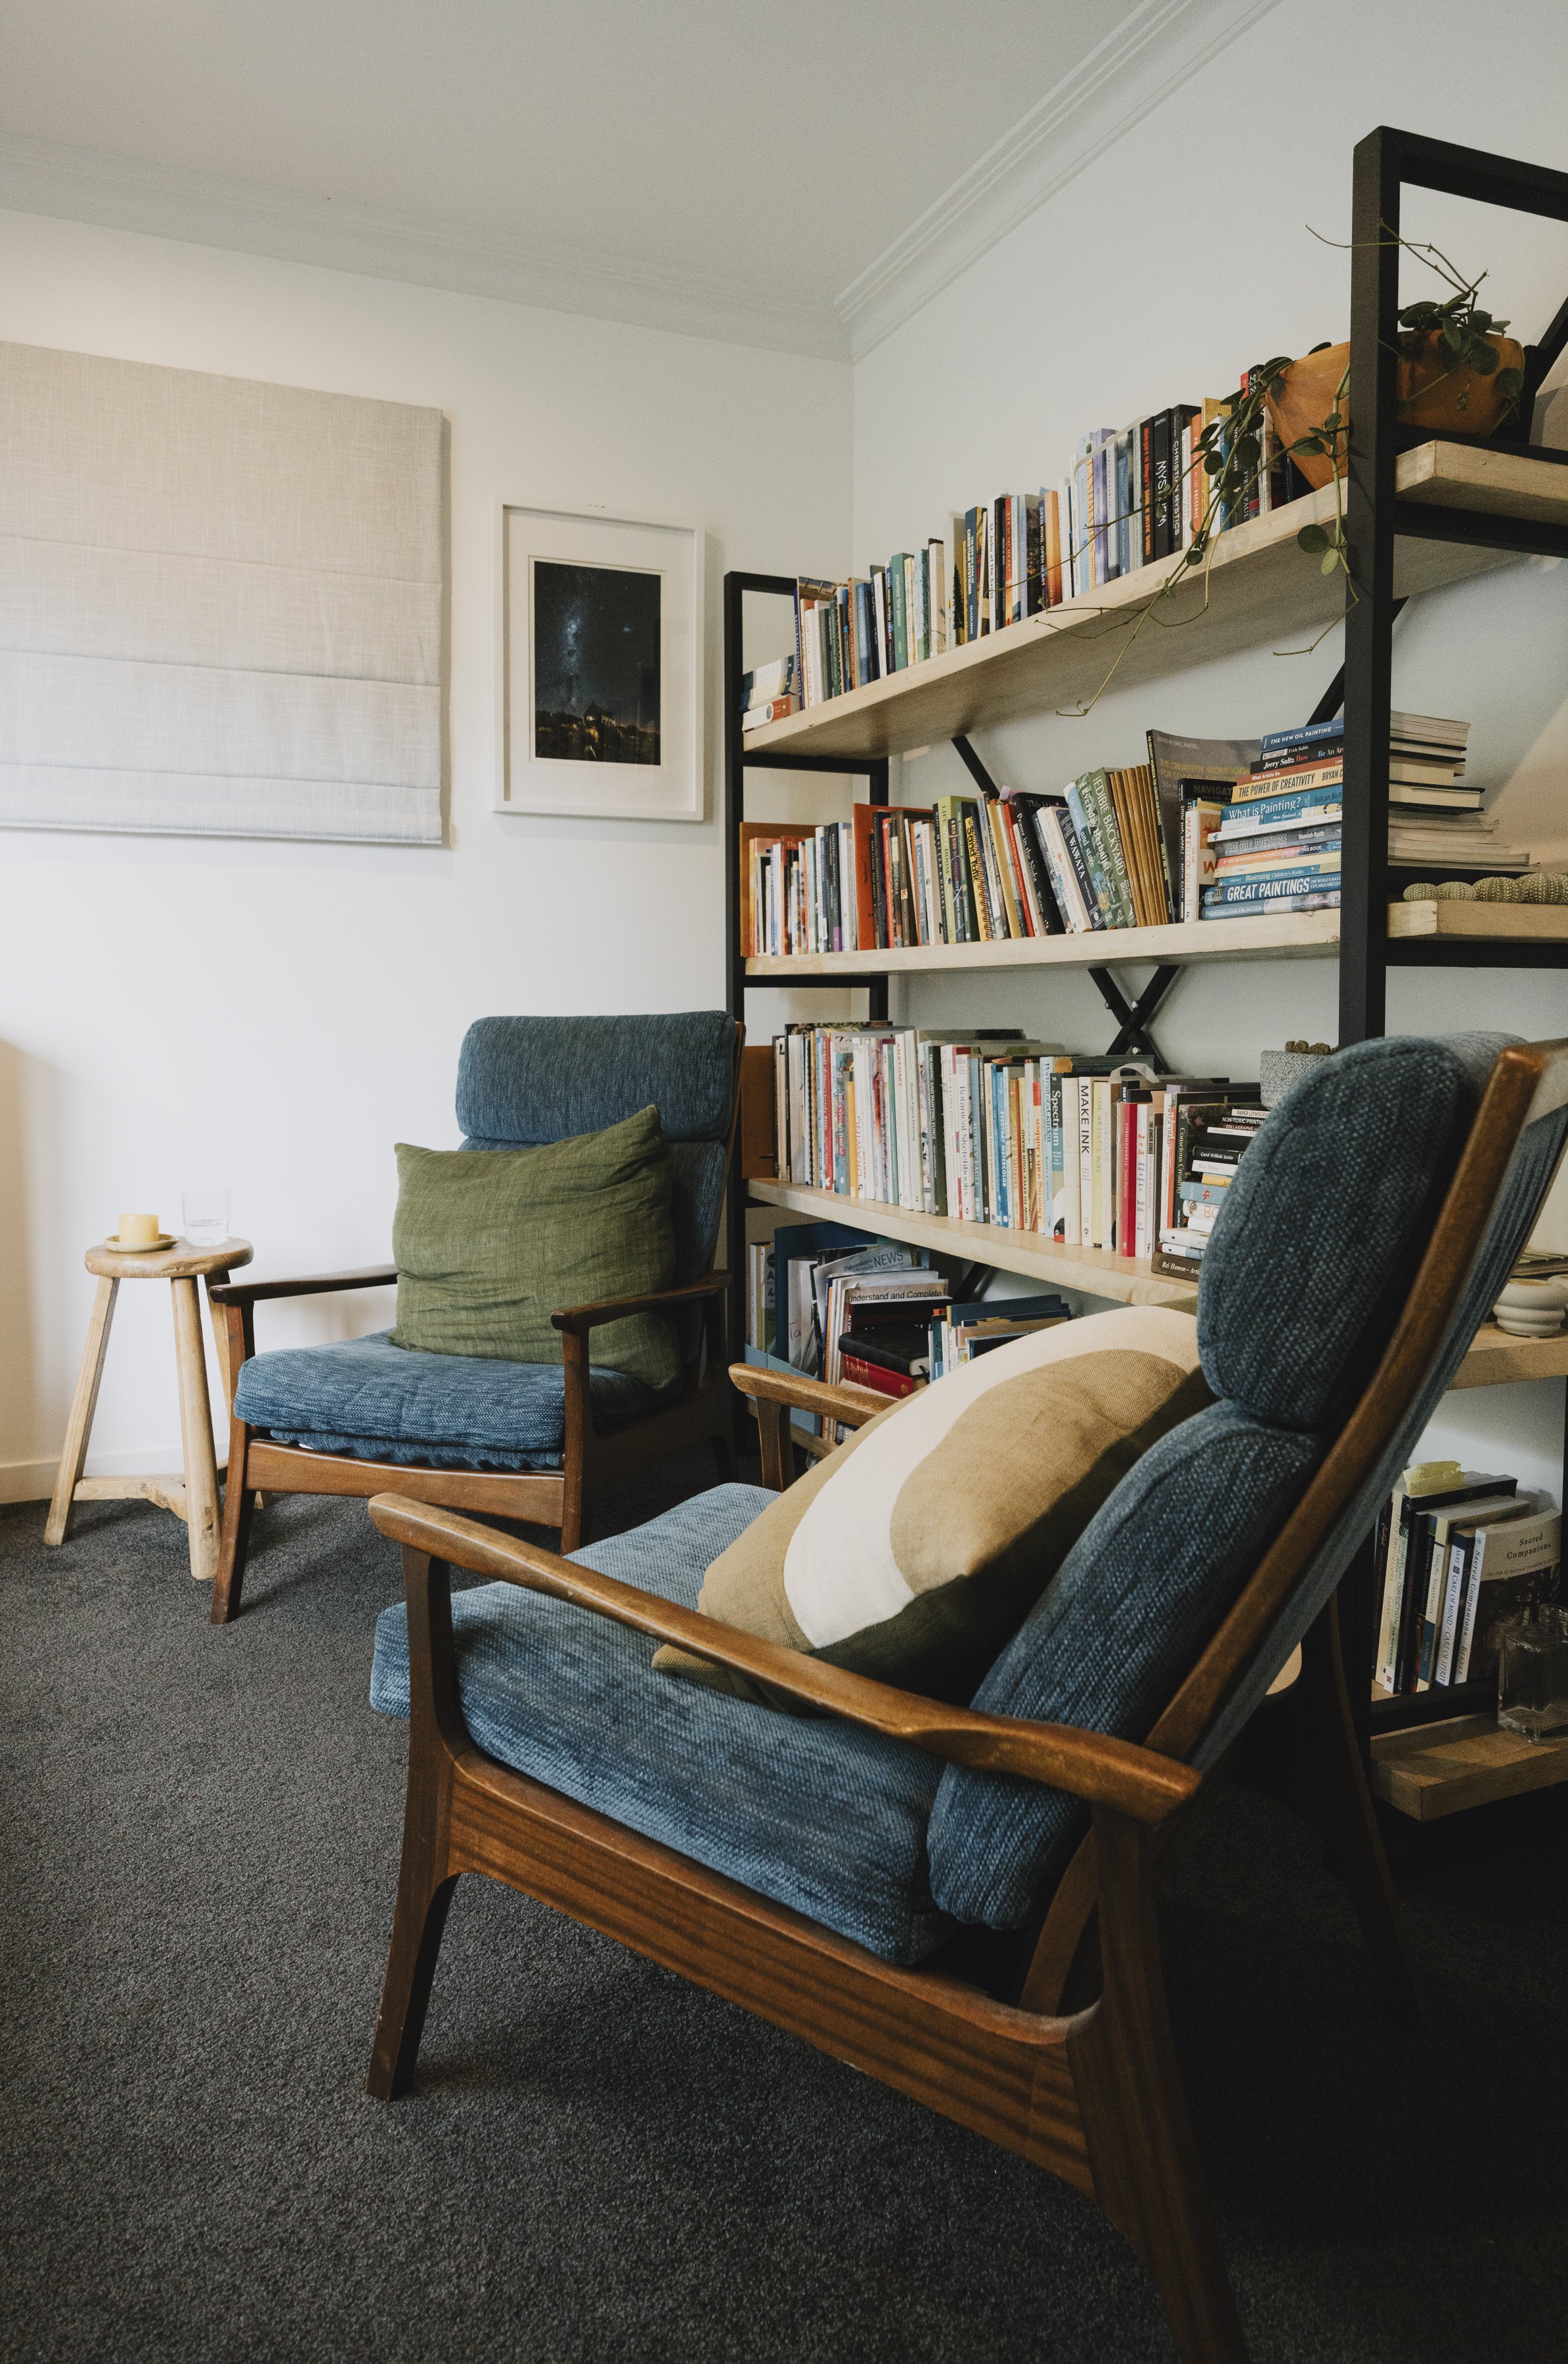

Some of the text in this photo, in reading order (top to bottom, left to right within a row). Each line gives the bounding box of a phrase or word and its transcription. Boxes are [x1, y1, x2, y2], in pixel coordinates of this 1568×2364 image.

[989, 554, 993, 564] of
[1305, 727, 1332, 737] PAINTING
[1263, 760, 1280, 770] Jerry
[1280, 757, 1295, 766] Saltz
[1239, 769, 1343, 798] THE POWER OF CREATIVITY BRYAN C
[1229, 797, 1301, 820] What is Painting?
[1068, 796, 1096, 868] to stand and stare
[1079, 787, 1111, 872] Everyday Herbalist
[1092, 779, 1110, 815] EDIBLE
[1101, 814, 1126, 876] BACKYARD
[966, 826, 980, 881] Sand Talk
[1224, 834, 1288, 853] THE BIG PICTURE
[1016, 814, 1027, 836] Prayer
[1022, 837, 1029, 845] in
[1035, 890, 1045, 913] Warren
[1068, 835, 1087, 879] WAWATA
[1244, 872, 1271, 882] Illustrating
[1227, 877, 1310, 902] GREAT PAINTINGS
[1051, 1090, 1061, 1146] Spectrum
[1080, 1085, 1089, 1154] MAKE INK
[959, 1086, 970, 1196] Botanical Sketchbooks
[1175, 1127, 1186, 1194] Conscious Creativity
[1023, 1195, 1028, 1204] TO
[873, 1250, 904, 1268] NEWS
[848, 1290, 942, 1303] Understand and Complete
[1506, 1541, 1551, 1559] Companions
[1519, 1533, 1544, 1547] Sacred
[1393, 1539, 1406, 1625] SPIRITUAL DIRECTION
[1448, 1593, 1456, 1603] OF
[1446, 1604, 1454, 1625] MIND
[1457, 1550, 1481, 1675] Sacred Companions BENNER
[1443, 1631, 1451, 1650] CARE
[1442, 1650, 1448, 1659] OF
[1439, 1659, 1448, 1682] SPIRIT
